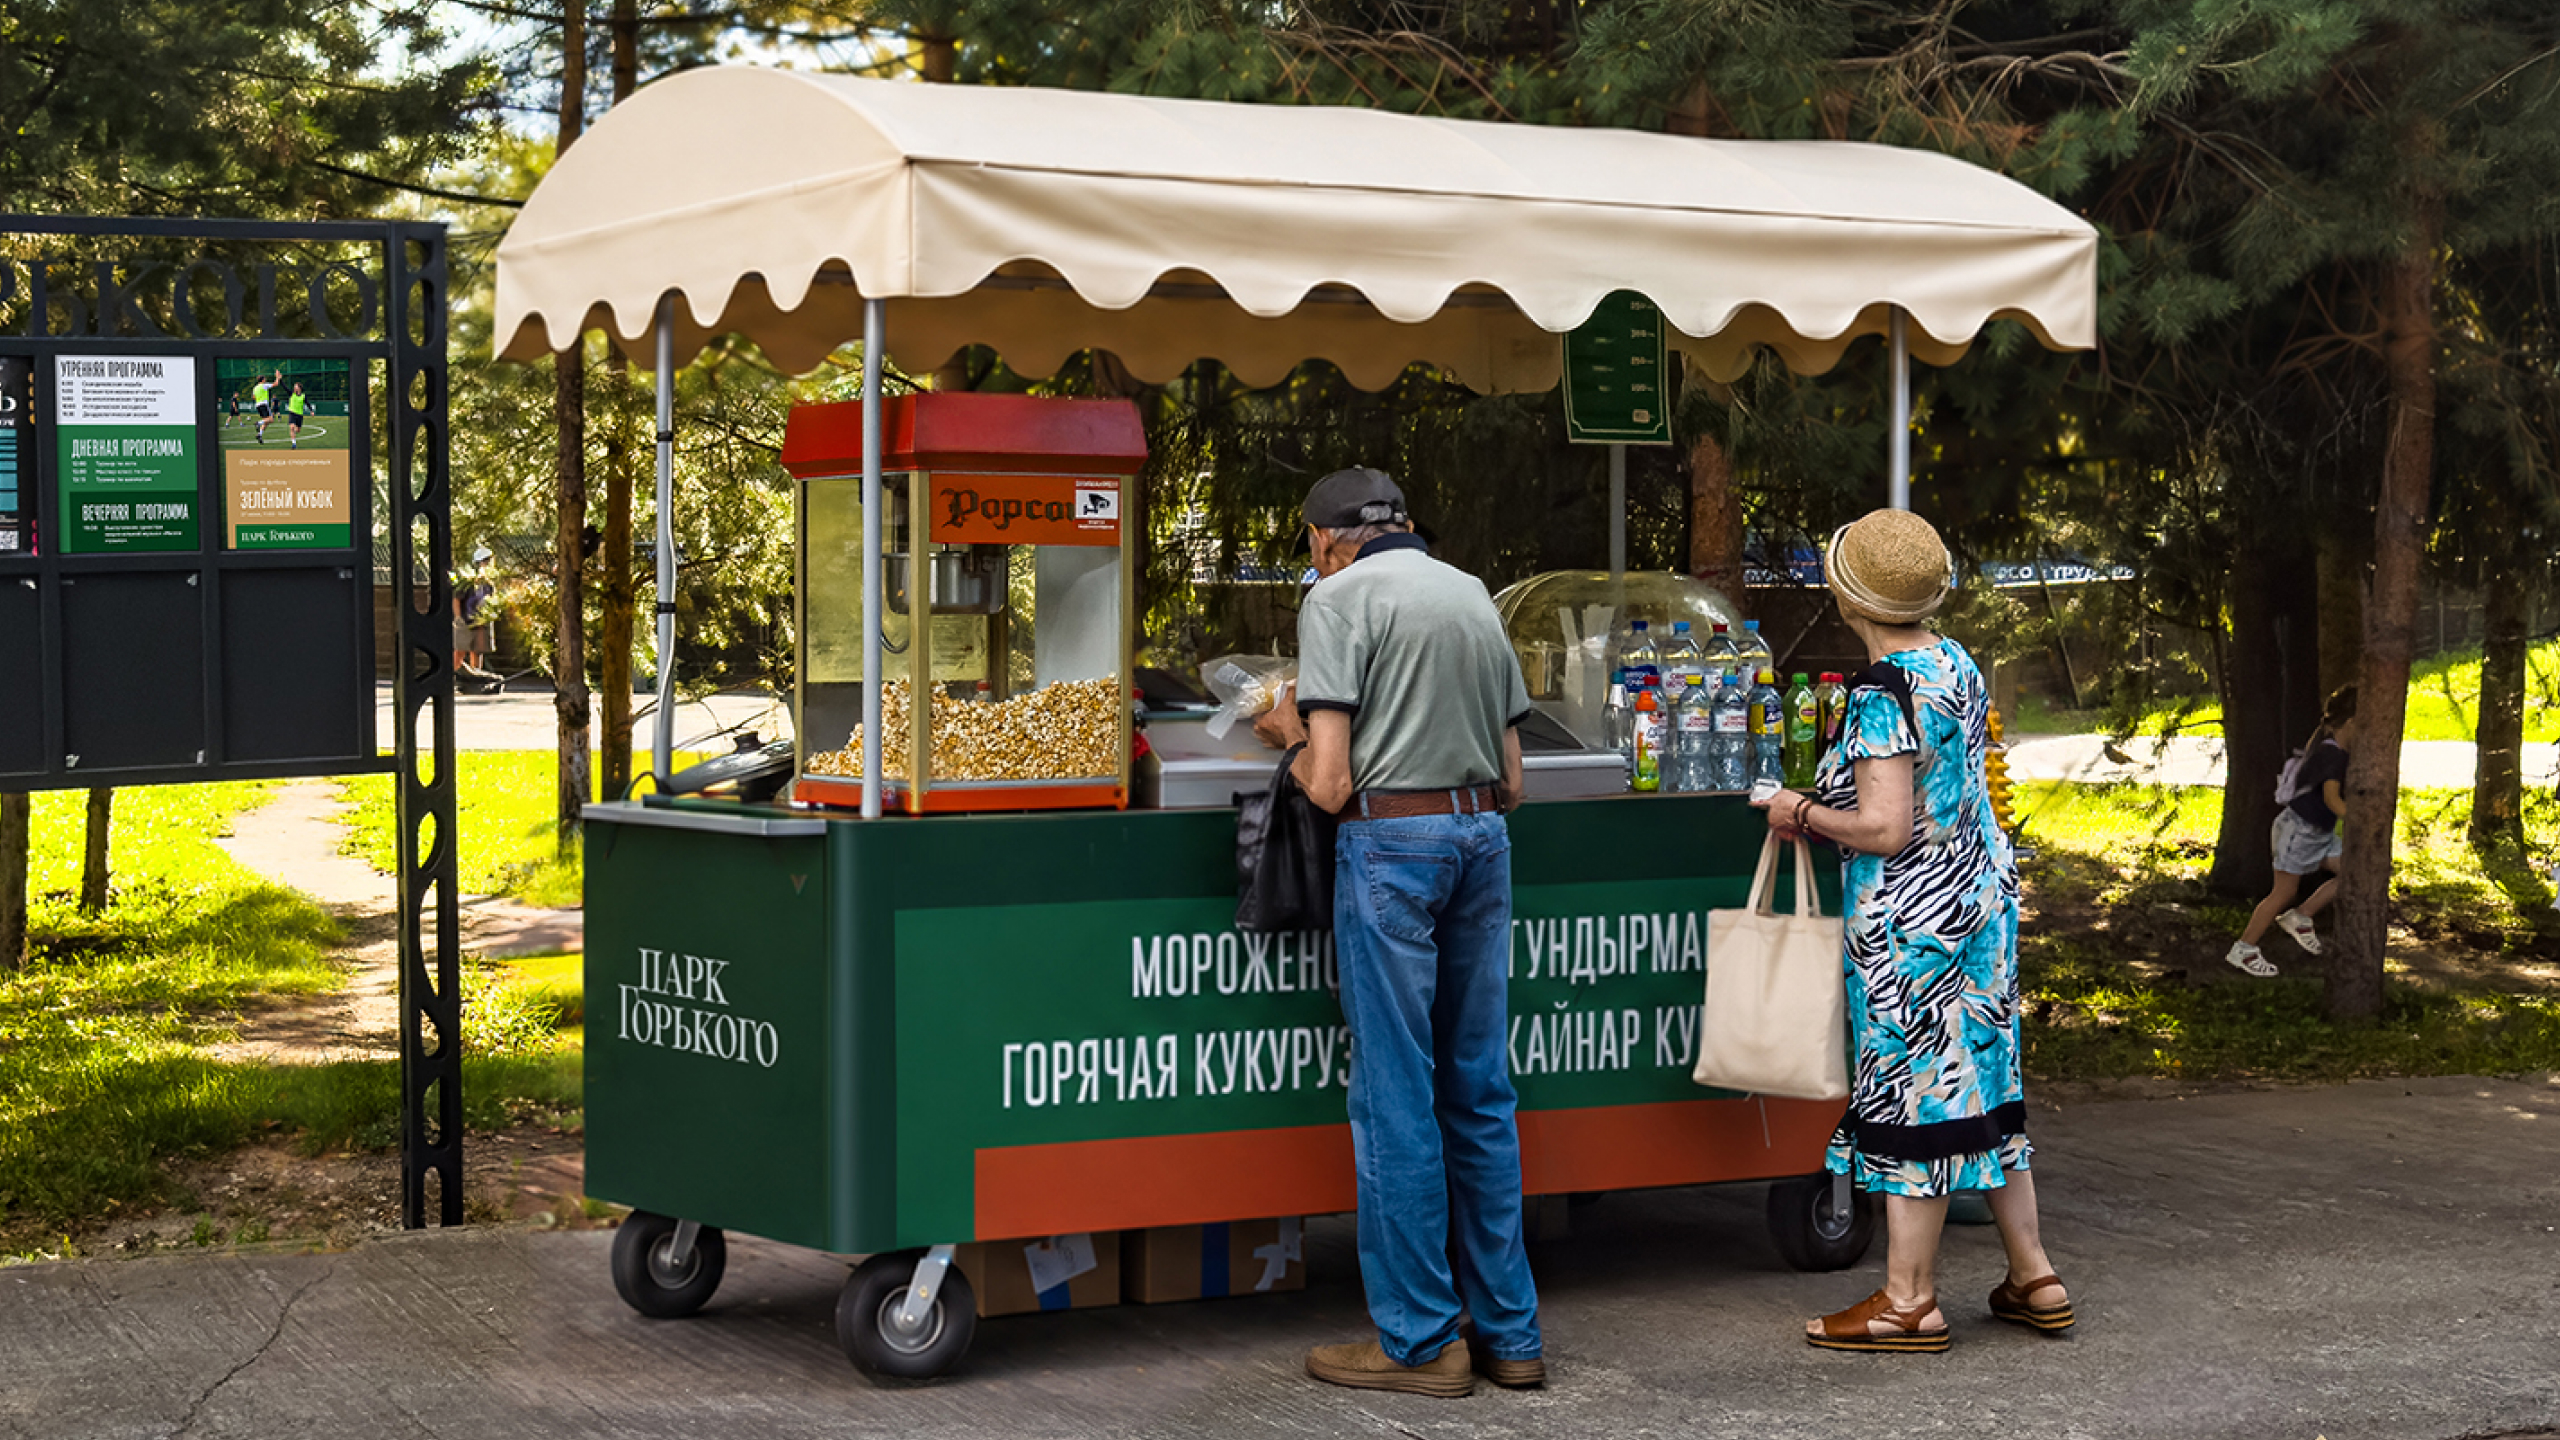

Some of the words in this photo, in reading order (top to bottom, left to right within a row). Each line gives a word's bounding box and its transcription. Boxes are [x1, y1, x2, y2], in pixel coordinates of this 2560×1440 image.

[60, 361, 105, 378] УТРЕННЯЯ
[108, 361, 164, 378] ПРОГРАММА
[71, 439, 119, 458] ДНЕВНАЯ
[122, 438, 183, 457] ПРОГРАММА
[239, 487, 293, 509] ЗЕЛЁНЫЙ
[297, 490, 333, 509] КУБОК
[82, 504, 130, 521] ВЕЧЕРНЯЯ
[135, 503, 189, 521] ПРОГРАММА
[241, 531, 267, 541] ПАРК
[638, 946, 730, 1006] ПАРК
[617, 983, 779, 1068] ГОРЬКОГО
[1002, 1034, 1179, 1108] ГОРЯЧАЯ
[1656, 1005, 1705, 1067] КУ
